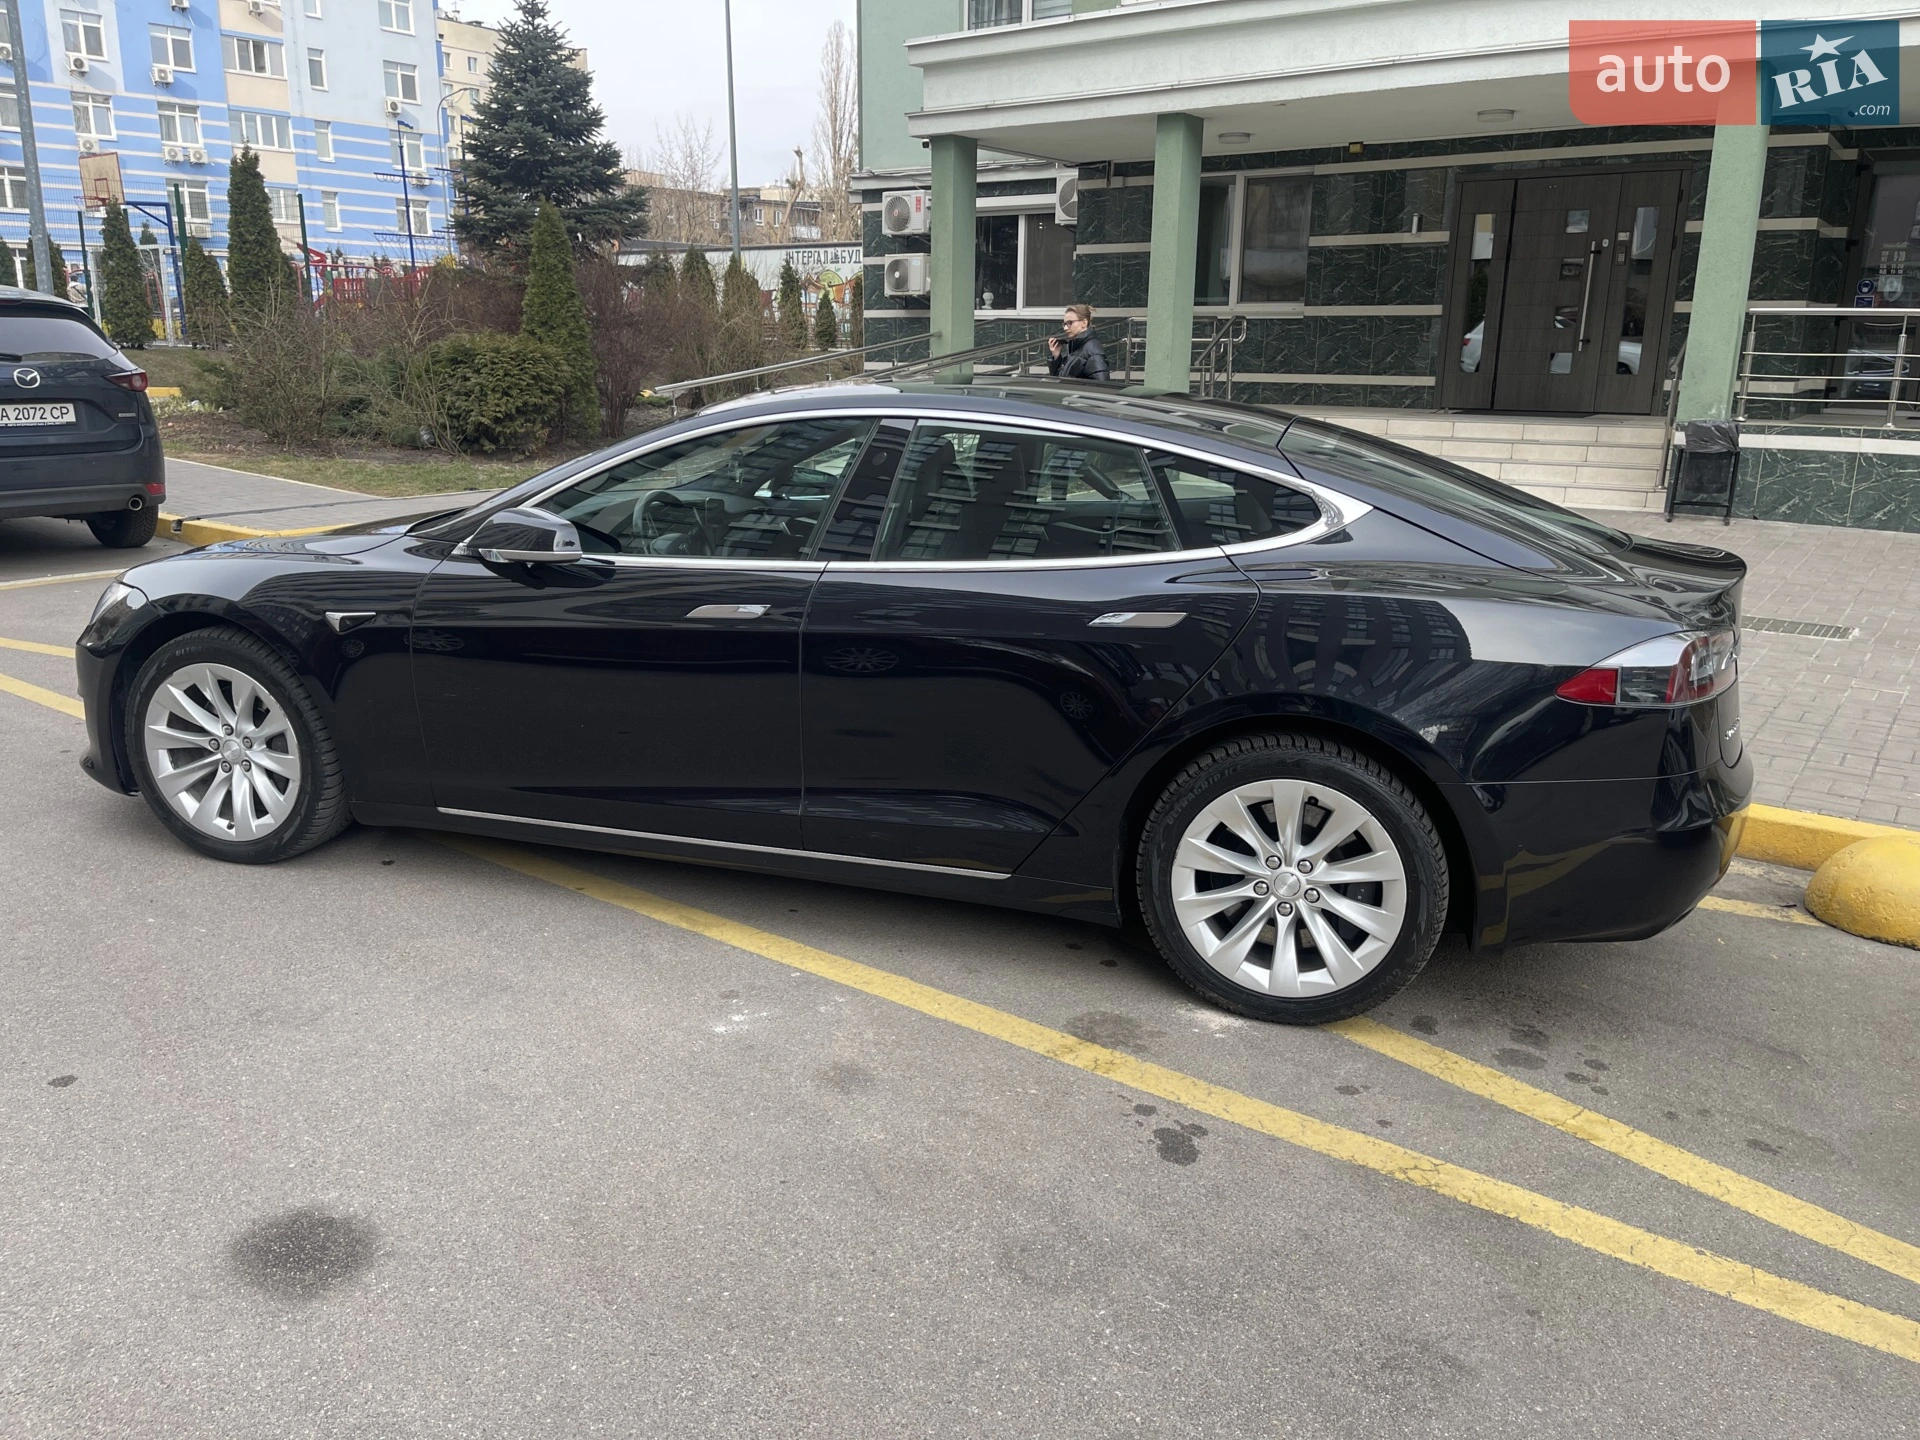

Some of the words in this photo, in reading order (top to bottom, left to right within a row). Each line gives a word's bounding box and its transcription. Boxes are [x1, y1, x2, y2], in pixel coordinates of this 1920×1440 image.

[840, 249, 862, 264] БУД
[13, 407, 48, 421] 2072
[50, 406, 70, 420] CP
